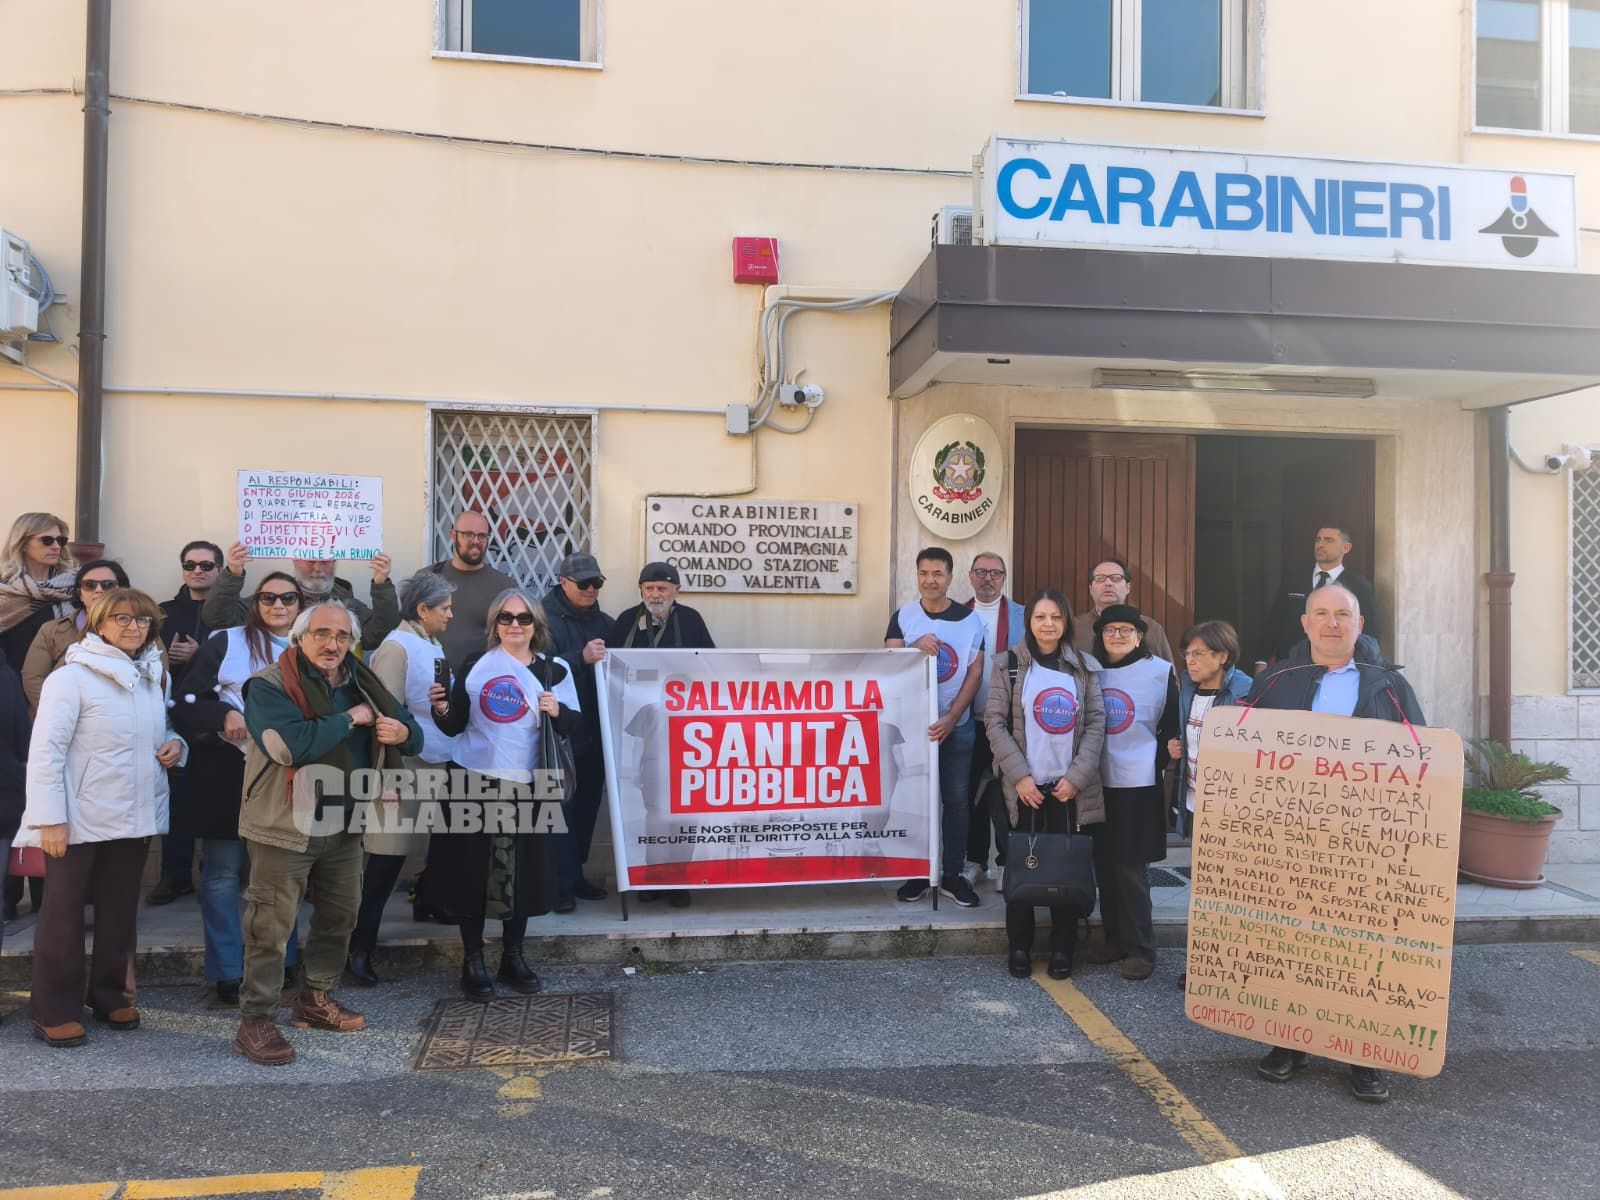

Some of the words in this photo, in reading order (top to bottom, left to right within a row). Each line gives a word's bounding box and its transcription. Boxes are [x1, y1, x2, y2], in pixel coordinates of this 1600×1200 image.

[997, 158, 1451, 241] CARABINIERI
[244, 488, 281, 497] ENTRO
[289, 490, 329, 499] GIUGNO
[335, 491, 360, 499] 2026
[249, 475, 260, 484] AI
[268, 475, 359, 488] RESPONSABILI:
[244, 499, 252, 508] O
[258, 498, 306, 508] RIAPRITE
[313, 501, 322, 509] IL
[328, 500, 375, 511] REPARTO
[245, 511, 254, 520] DI
[262, 511, 328, 521] PSICHIATRIA
[335, 513, 342, 522] A
[349, 514, 371, 523] VIBO
[692, 504, 817, 521] CARABINIERI
[918, 495, 993, 524] CARABINIERI
[245, 523, 252, 532] O
[261, 524, 348, 536] DIMETTETEVI
[652, 522, 737, 537] COMANDO
[748, 524, 853, 539] PROVINCIALE
[246, 546, 287, 557] OMITATO
[294, 548, 323, 559] CIVILE
[329, 549, 346, 559] SAN
[659, 539, 746, 554] COMANDO
[756, 541, 849, 556] COMPAGNIA
[666, 557, 752, 571] COMANDO
[763, 559, 839, 573] STAZIONE
[685, 573, 727, 588] VIBO
[743, 574, 821, 589] VALENTIA
[665, 680, 834, 711] SALVIAMO
[845, 679, 884, 710] LA
[682, 714, 870, 768] SANITÀ
[1213, 726, 1263, 743] CARA
[1277, 730, 1351, 751] REGIONE
[1364, 740, 1376, 753] E
[680, 765, 868, 806] PUBBLICA
[1315, 756, 1429, 789] BASTA!
[1203, 766, 1233, 784] CON
[1242, 773, 1246, 785] I
[1255, 776, 1327, 798] SERVIZI
[1341, 785, 1432, 811] SANITARI
[1203, 783, 1239, 799] CHE
[1249, 791, 1265, 804] CI
[1276, 796, 1363, 818] VENGONO
[1368, 807, 1428, 829] TOLTI
[638, 834, 736, 845] RECUPERARE
[739, 834, 752, 843] IL
[755, 833, 811, 843] DIRITTO
[815, 831, 852, 841] ALLA
[855, 828, 908, 840] SALUTE
[680, 825, 698, 834] LE
[700, 824, 759, 834] NOSTRE
[762, 822, 839, 833] PROPOSTE
[841, 821, 868, 831] PER
[1200, 817, 1210, 828] A
[1218, 819, 1274, 840] SERRA
[1284, 829, 1317, 847] SAN
[1202, 800, 1214, 813] E
[1223, 803, 1331, 833] L'OSPEDALE
[1341, 821, 1371, 838] CHE
[1380, 827, 1449, 849] MUORE
[1198, 847, 1248, 863] NOSTRO
[1254, 856, 1303, 873] GIUSTO
[1309, 864, 1367, 883] DIRITTO
[1376, 876, 1388, 887] DI
[1200, 833, 1226, 847] NON
[1233, 838, 1278, 855] SIAMO
[1286, 846, 1375, 869] RISPETTATI
[1387, 863, 1421, 877] NEL
[1193, 886, 1297, 911] STABILIMENTO
[1197, 861, 1224, 874] NON
[1234, 867, 1280, 883] SIAMO
[1289, 876, 1337, 893] MERCE
[1375, 890, 1428, 908] CARNE
[1196, 874, 1214, 884] DA
[1220, 877, 1286, 897] MACELLO
[1297, 890, 1313, 901] DA
[1320, 895, 1390, 915] SPOSTARE
[1397, 908, 1415, 920] DA
[1422, 913, 1450, 927] UNO
[1192, 926, 1249, 945] SERVIZI
[1193, 898, 1302, 928] RIVENDICHIAMO
[1311, 920, 1327, 932] LA
[1332, 925, 1385, 943] NOSTRA
[1219, 915, 1232, 926] IL
[1239, 920, 1287, 938] NOSTRO
[1391, 950, 1442, 969] NOSTRI
[1190, 954, 1224, 968] STRA
[1233, 961, 1285, 980] POLITICA
[1295, 973, 1378, 1003] SANITARIA
[1192, 939, 1220, 954] NON
[1227, 947, 1239, 958] CI
[1246, 950, 1357, 984] ABBATTERETE
[1367, 977, 1407, 995] ALLA
[1188, 982, 1230, 1001] LOTTA
[1238, 991, 1279, 1011] CIVILE
[1287, 1002, 1308, 1016] AD
[1192, 1004, 1255, 1031] COMITATO
[1264, 1019, 1313, 1044] CIVICO
[1323, 1035, 1353, 1056] SAN
[1362, 1042, 1419, 1070] BRUNO
